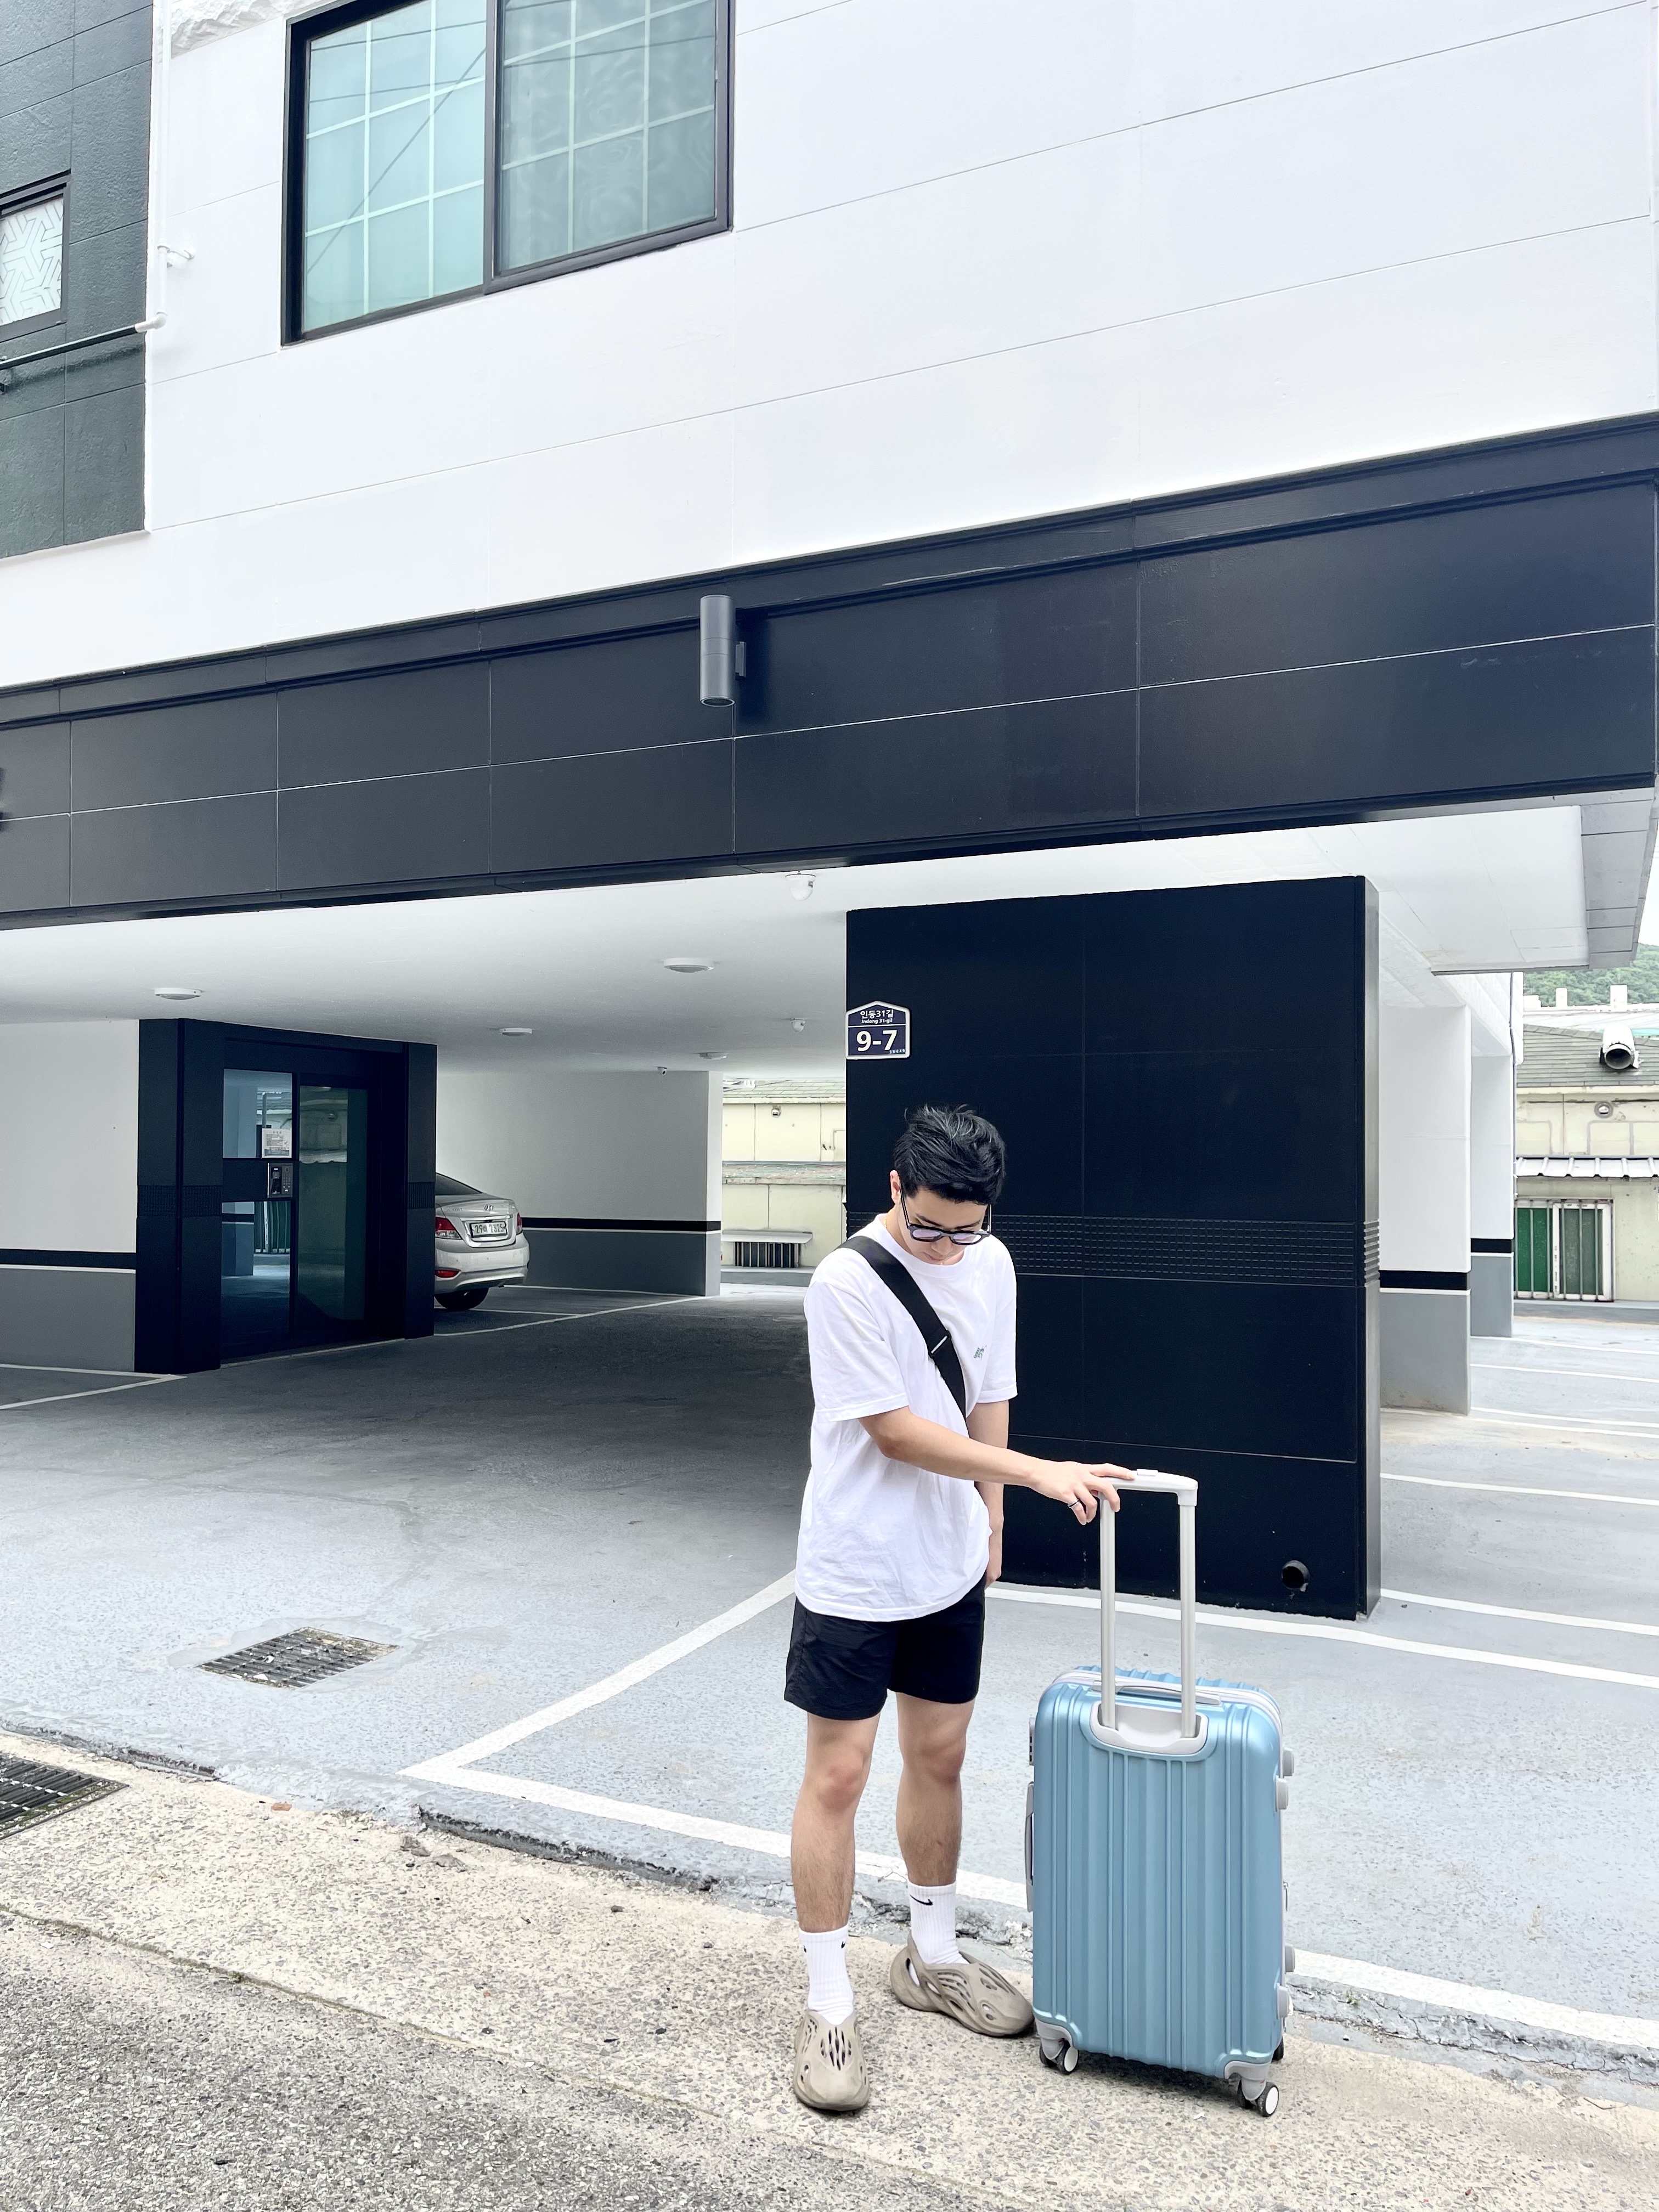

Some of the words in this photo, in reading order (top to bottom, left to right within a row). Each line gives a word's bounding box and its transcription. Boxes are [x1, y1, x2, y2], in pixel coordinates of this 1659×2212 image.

[860, 1009, 894, 1019] 인동31길
[856, 1030, 897, 1052] 9-7
[489, 1223, 504, 1233] 7325
